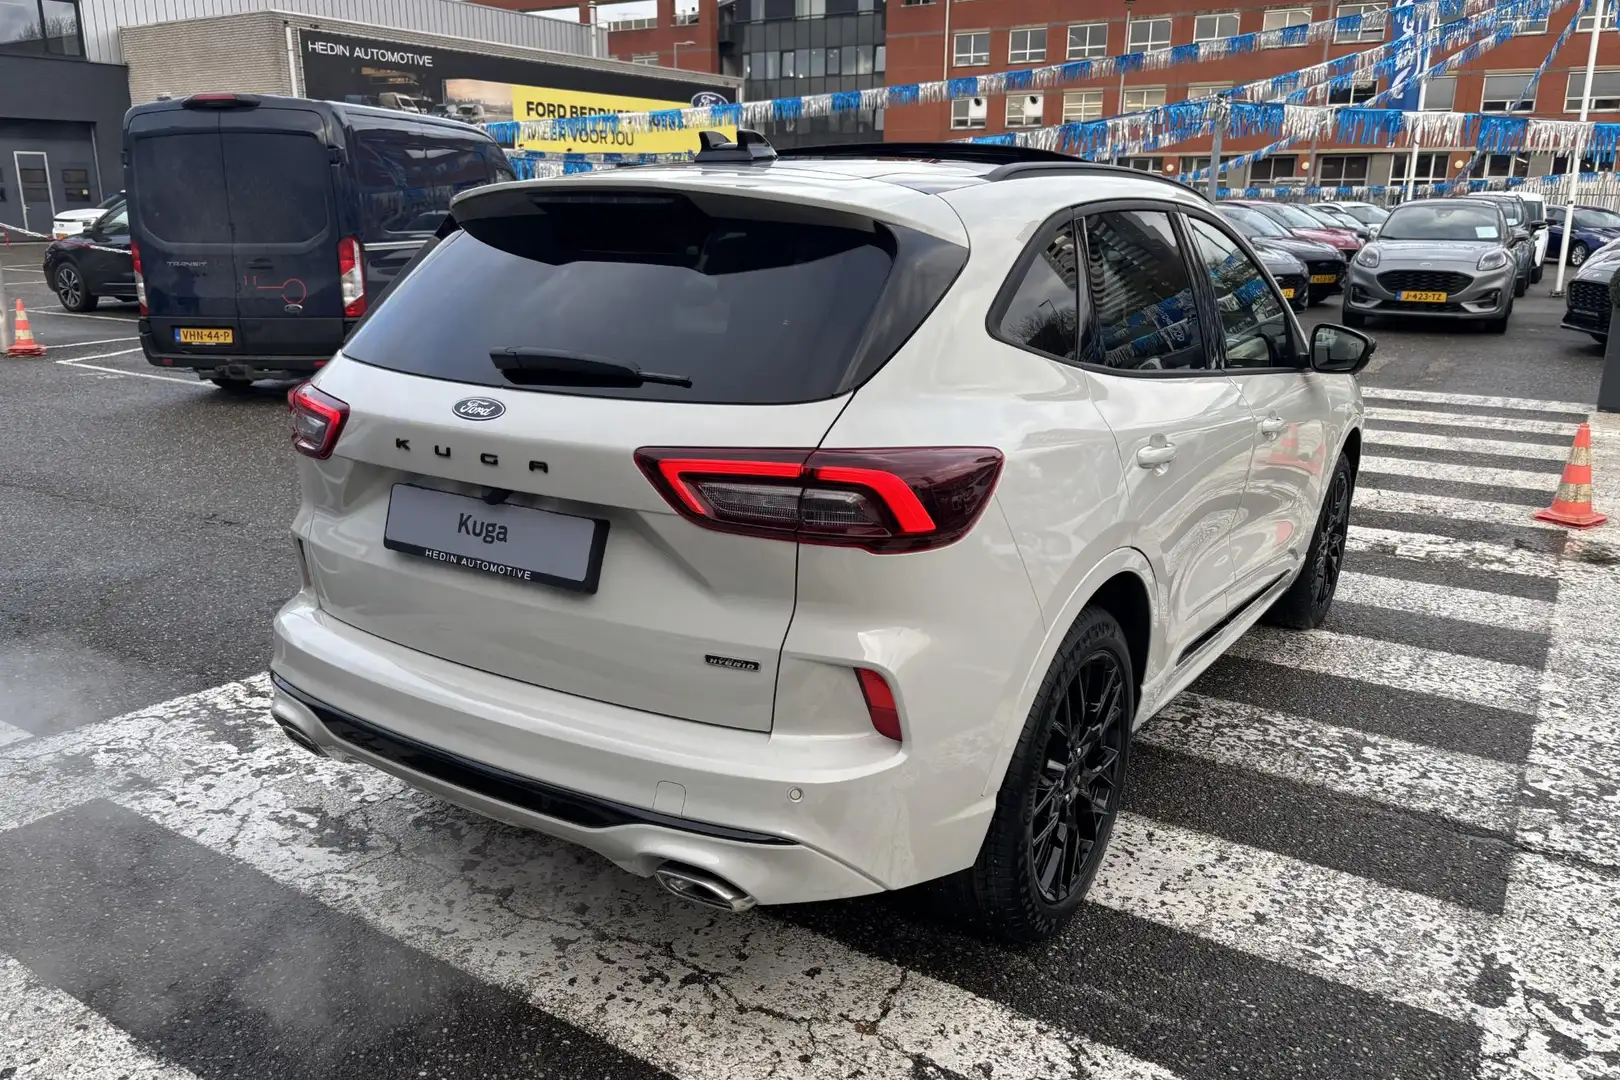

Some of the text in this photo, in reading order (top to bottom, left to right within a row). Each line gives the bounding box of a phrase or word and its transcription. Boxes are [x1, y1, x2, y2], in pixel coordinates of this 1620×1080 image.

[307, 40, 434, 67] HEDIN AUTOMOTIVE
[526, 100, 567, 118] FORD
[570, 126, 608, 144] VOOR
[610, 129, 635, 146] JOU
[1404, 291, 1443, 301] J-423-TZ
[181, 330, 231, 342] VHN-44-P
[459, 399, 496, 416] Ford
[395, 438, 549, 474] KUGA
[457, 512, 509, 544] Kuga
[425, 548, 532, 580] HEDIN AUTOMOTIVE
[709, 658, 756, 670] HYBRID
